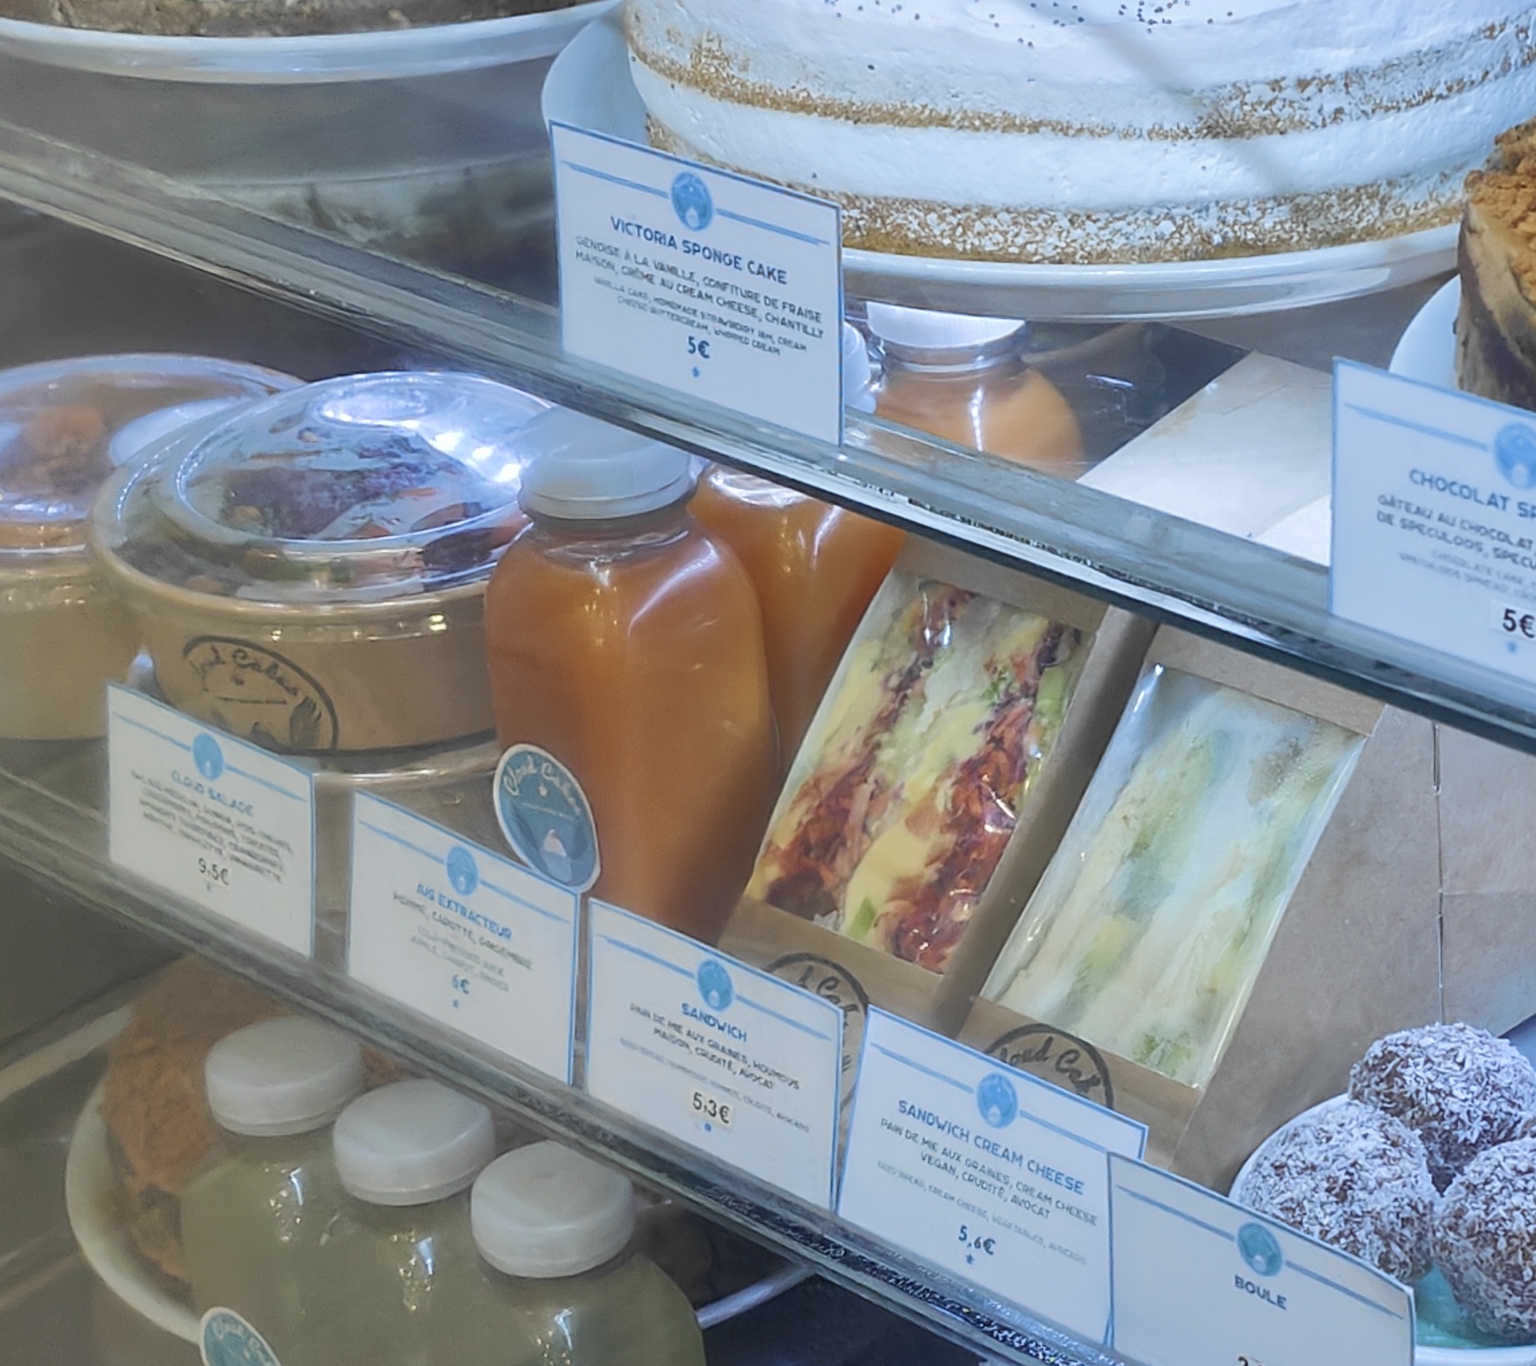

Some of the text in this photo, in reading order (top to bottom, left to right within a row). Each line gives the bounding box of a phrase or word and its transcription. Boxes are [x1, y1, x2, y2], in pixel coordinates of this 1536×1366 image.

[611, 216, 787, 284] VICTORIA SPONGE CAKE
[624, 250, 631, 260] À
[634, 254, 649, 267] LA
[653, 260, 699, 286] VANILLE,
[703, 276, 760, 303] CONFITURE
[764, 296, 778, 309] DE
[782, 302, 821, 323] FRAISE
[660, 278, 673, 290] AU
[676, 283, 713, 303] CREAM
[716, 297, 762, 322] CHEESE,
[765, 312, 823, 338] CHANTILLY
[688, 336, 710, 358] 5€
[1410, 469, 1510, 511] CHOCOLAT
[1377, 510, 1394, 526] DE
[1400, 518, 1488, 558] SPECULOOS,
[1437, 513, 1456, 526] AU
[1503, 609, 1534, 638] 5€
[416, 884, 435, 901] JUS
[438, 894, 511, 939] EXTRACTEUR
[682, 1003, 746, 1042] SANDWICH
[1000, 1036, 1054, 1069] loud
[693, 1092, 729, 1124] 5,3€
[899, 1100, 1084, 1195] SANDWICH CREAM CHEESE
[905, 1129, 918, 1143] DE
[941, 1147, 961, 1162] AUX
[1016, 1182, 1052, 1205] CREAM
[921, 1152, 958, 1179] VEGAN,
[1011, 1195, 1050, 1218] AVOCAT
[959, 1225, 995, 1255] 5,6€
[1235, 1275, 1288, 1311] BOULE
